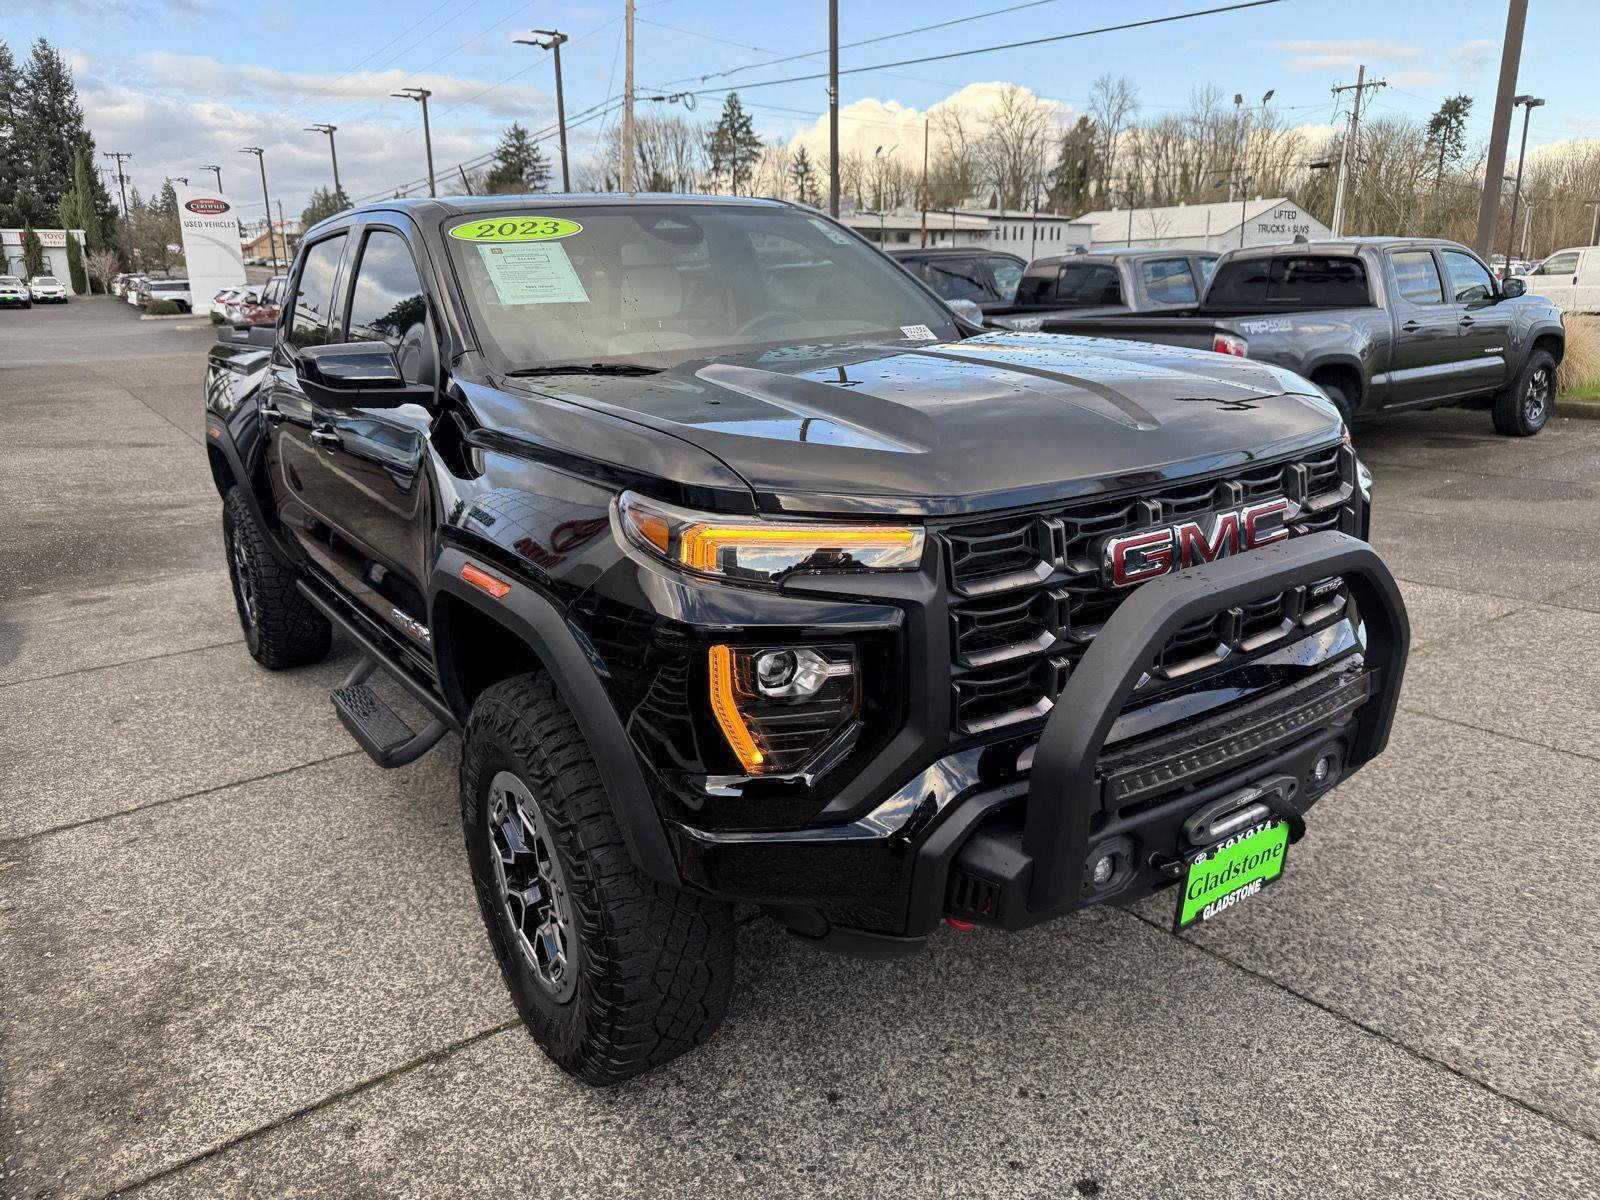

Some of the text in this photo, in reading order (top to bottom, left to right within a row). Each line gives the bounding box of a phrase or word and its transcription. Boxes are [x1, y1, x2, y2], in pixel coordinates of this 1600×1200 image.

[204, 221, 236, 229] VEHICLES
[1274, 210, 1297, 219] LIFTED
[475, 221, 560, 238] 2023
[1257, 224, 1285, 234] TRUCKS
[1107, 497, 1290, 588] GMC
[1216, 820, 1272, 853] TOYOTA
[1187, 842, 1283, 901] Gladstone
[1203, 878, 1263, 921] GLADSTONE
